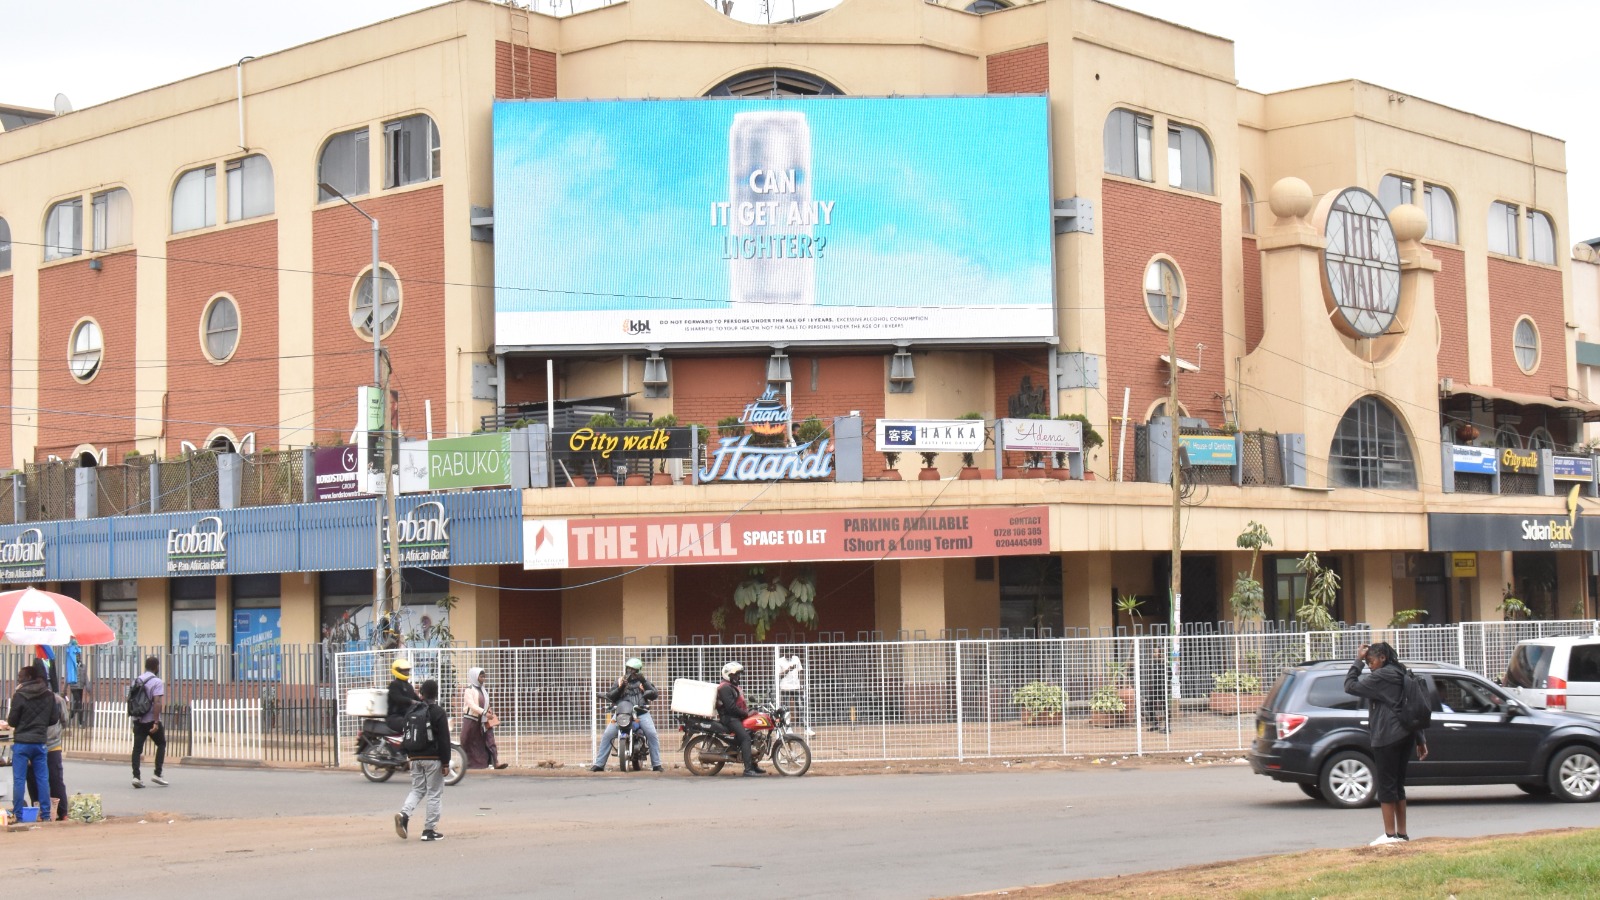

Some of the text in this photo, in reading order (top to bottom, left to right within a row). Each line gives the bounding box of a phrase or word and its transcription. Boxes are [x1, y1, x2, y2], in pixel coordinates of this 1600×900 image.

[749, 169, 796, 194] CAN
[711, 201, 835, 226] IT GET ANY
[1332, 203, 1381, 261] THE
[722, 235, 827, 259] LIGHTER?
[1339, 261, 1390, 320] MALL
[630, 320, 651, 333] kbl
[888, 429, 913, 442] 客家
[921, 427, 976, 439] HAKKA
[1015, 422, 1065, 442] Adena
[569, 428, 671, 458] City walk
[1193, 442, 1234, 452] House of Dentistry
[432, 449, 500, 478] RABUKO
[699, 434, 835, 482] Haandi
[1503, 448, 1538, 472] City walk
[342, 482, 356, 490] GROUP
[844, 516, 969, 532] PARKING AVAILABLE
[1010, 516, 1041, 526] CONTACT
[167, 516, 228, 554] Ecobank
[572, 522, 738, 561] THE MALL
[743, 529, 826, 546] SPACE TO LET
[994, 528, 1011, 537] 0728
[1013, 528, 1026, 536] 106
[0, 528, 46, 562] Ecobank
[844, 536, 973, 552] (Short & Long Term)
[167, 559, 225, 571] The Pan African Bank
[406, 548, 450, 562] African Bank
